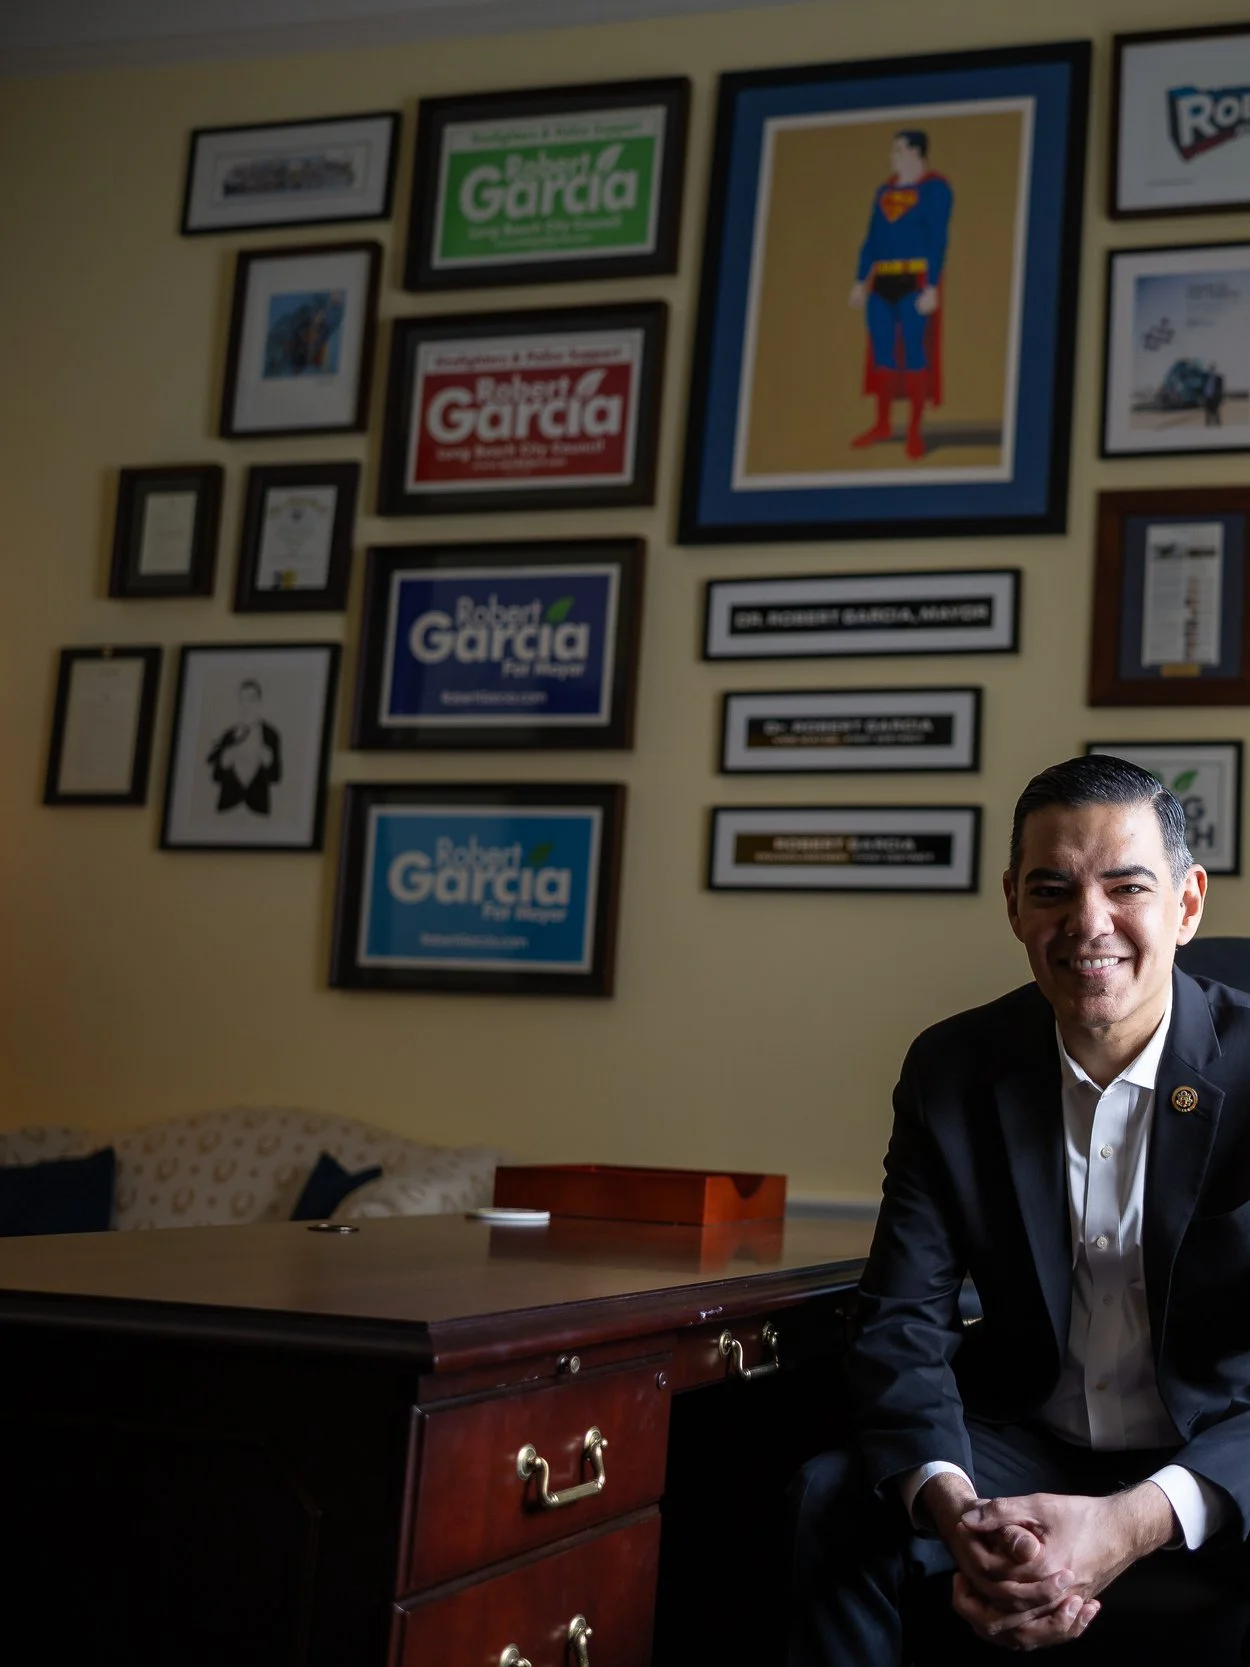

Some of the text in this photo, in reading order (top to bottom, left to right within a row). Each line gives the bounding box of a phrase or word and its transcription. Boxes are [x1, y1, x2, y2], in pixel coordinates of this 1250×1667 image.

[505, 151, 590, 181] Robert
[475, 373, 572, 401] Robert
[455, 593, 542, 626] Robert
[767, 608, 839, 627] ROBERT
[919, 603, 989, 621] MAYOR
[502, 661, 585, 681] For Mayor
[435, 834, 522, 867] Robert
[481, 903, 568, 925] For Mayor
